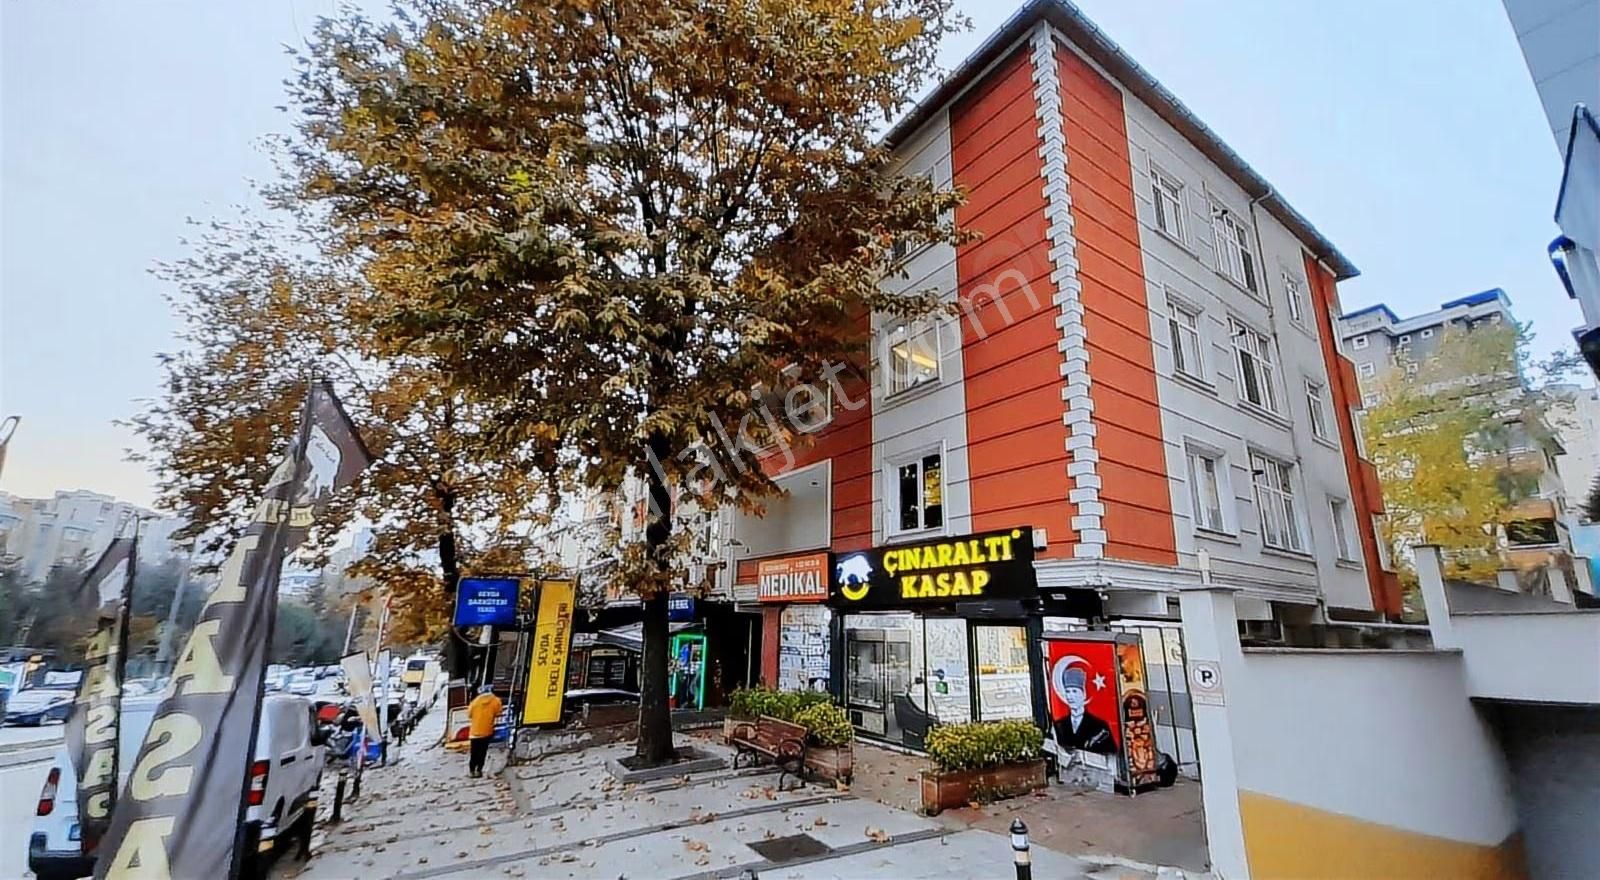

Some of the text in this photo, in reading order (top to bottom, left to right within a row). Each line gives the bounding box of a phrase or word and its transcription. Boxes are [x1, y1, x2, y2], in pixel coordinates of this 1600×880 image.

[883, 536, 1013, 578] ÇINARALTI
[760, 567, 825, 597] MEDİKAL
[901, 570, 990, 599] KASAP
[537, 632, 550, 667] SEVDA
[547, 668, 560, 698] TEKEL
[1201, 670, 1213, 683] P
